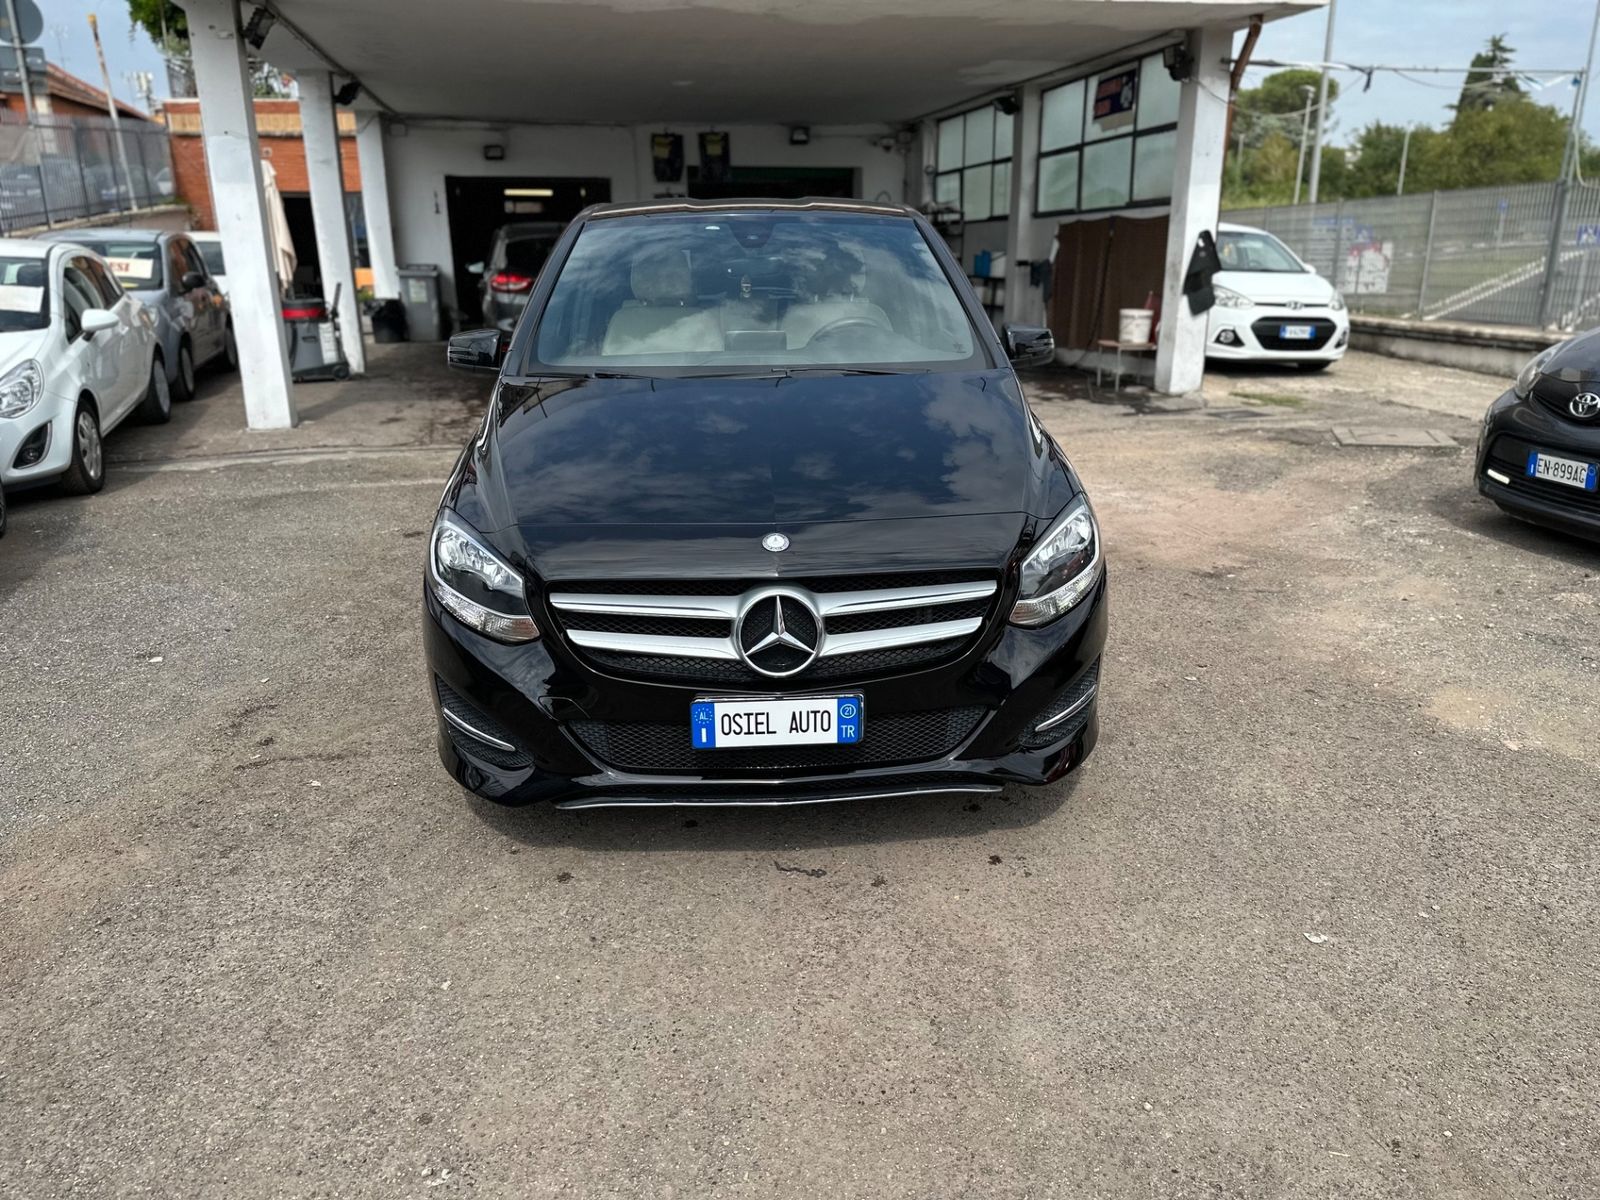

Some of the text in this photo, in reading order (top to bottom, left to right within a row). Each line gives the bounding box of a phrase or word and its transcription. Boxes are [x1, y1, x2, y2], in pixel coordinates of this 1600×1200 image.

[699, 711, 709, 720] AL
[721, 709, 831, 736] OSIEL AUTO
[701, 727, 707, 743] I
[840, 724, 855, 738] TR
